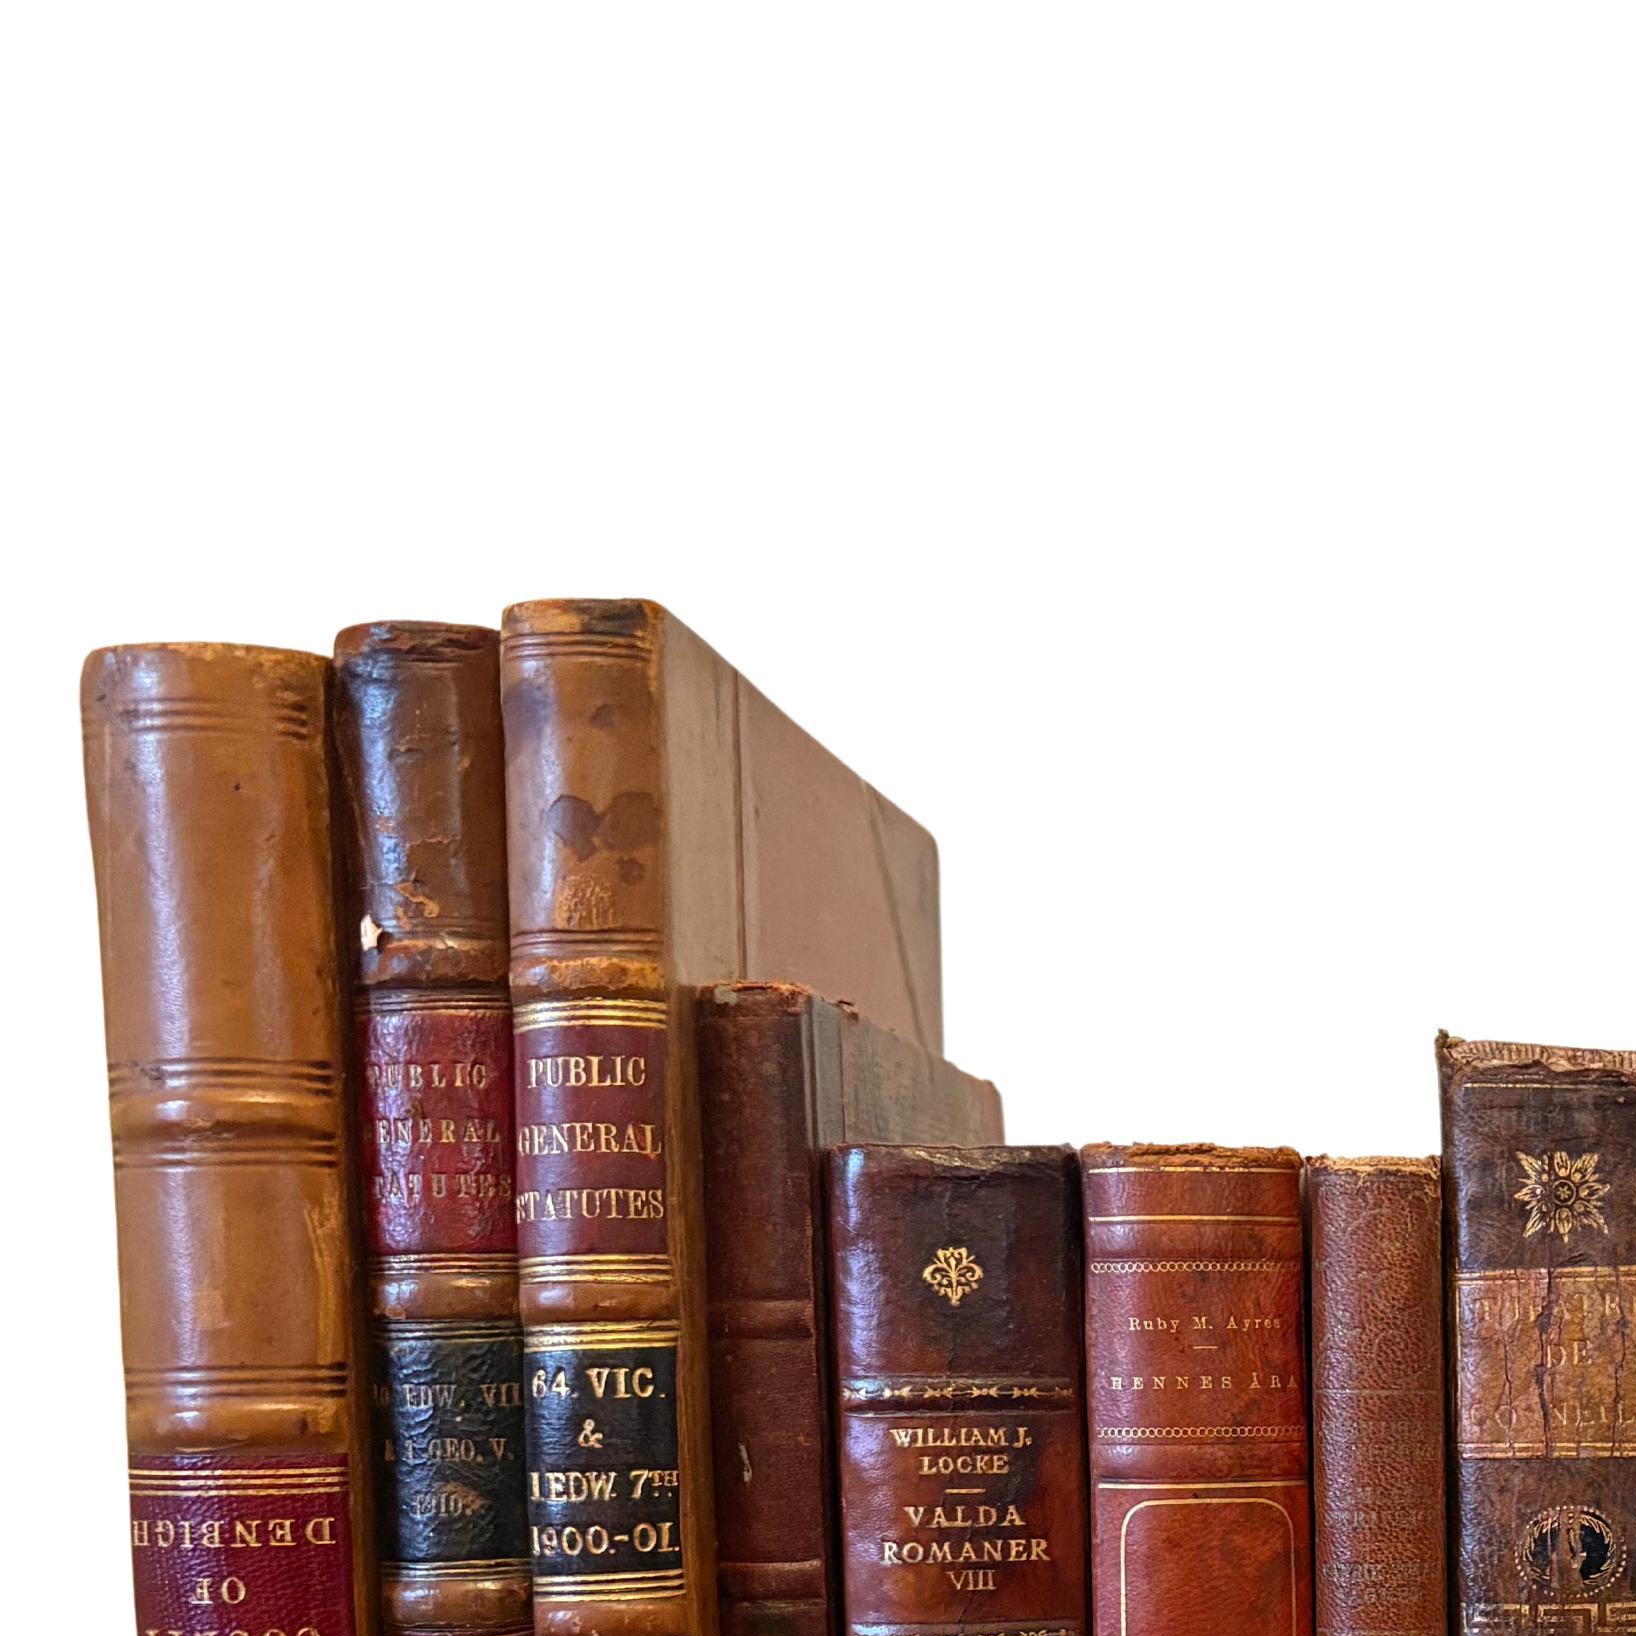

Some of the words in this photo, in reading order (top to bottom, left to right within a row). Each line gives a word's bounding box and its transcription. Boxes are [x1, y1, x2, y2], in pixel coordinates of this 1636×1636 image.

[527, 1055, 647, 1089] PUBLIC
[376, 1117, 501, 1144] ENERAL
[518, 1122, 663, 1157] GENERAL
[373, 1172, 513, 1200] TATUTES
[516, 1188, 665, 1225] STATUTES
[1128, 1316, 1181, 1334] Ruby
[1192, 1315, 1215, 1331] M.
[1546, 1339, 1593, 1369] DE
[1109, 1375, 1233, 1391] HENNES
[577, 1418, 604, 1449] &
[889, 1426, 1009, 1448] WILLIAM
[1014, 1426, 1034, 1448] J.
[427, 1437, 485, 1464] GEO.
[918, 1455, 1010, 1476] LOCKE
[903, 1504, 1027, 1529] VALDA
[132, 1517, 337, 1548] DENBIGH
[879, 1538, 1051, 1566] ROMANER
[190, 1576, 246, 1605] OF
[945, 1569, 998, 1591] VIII
